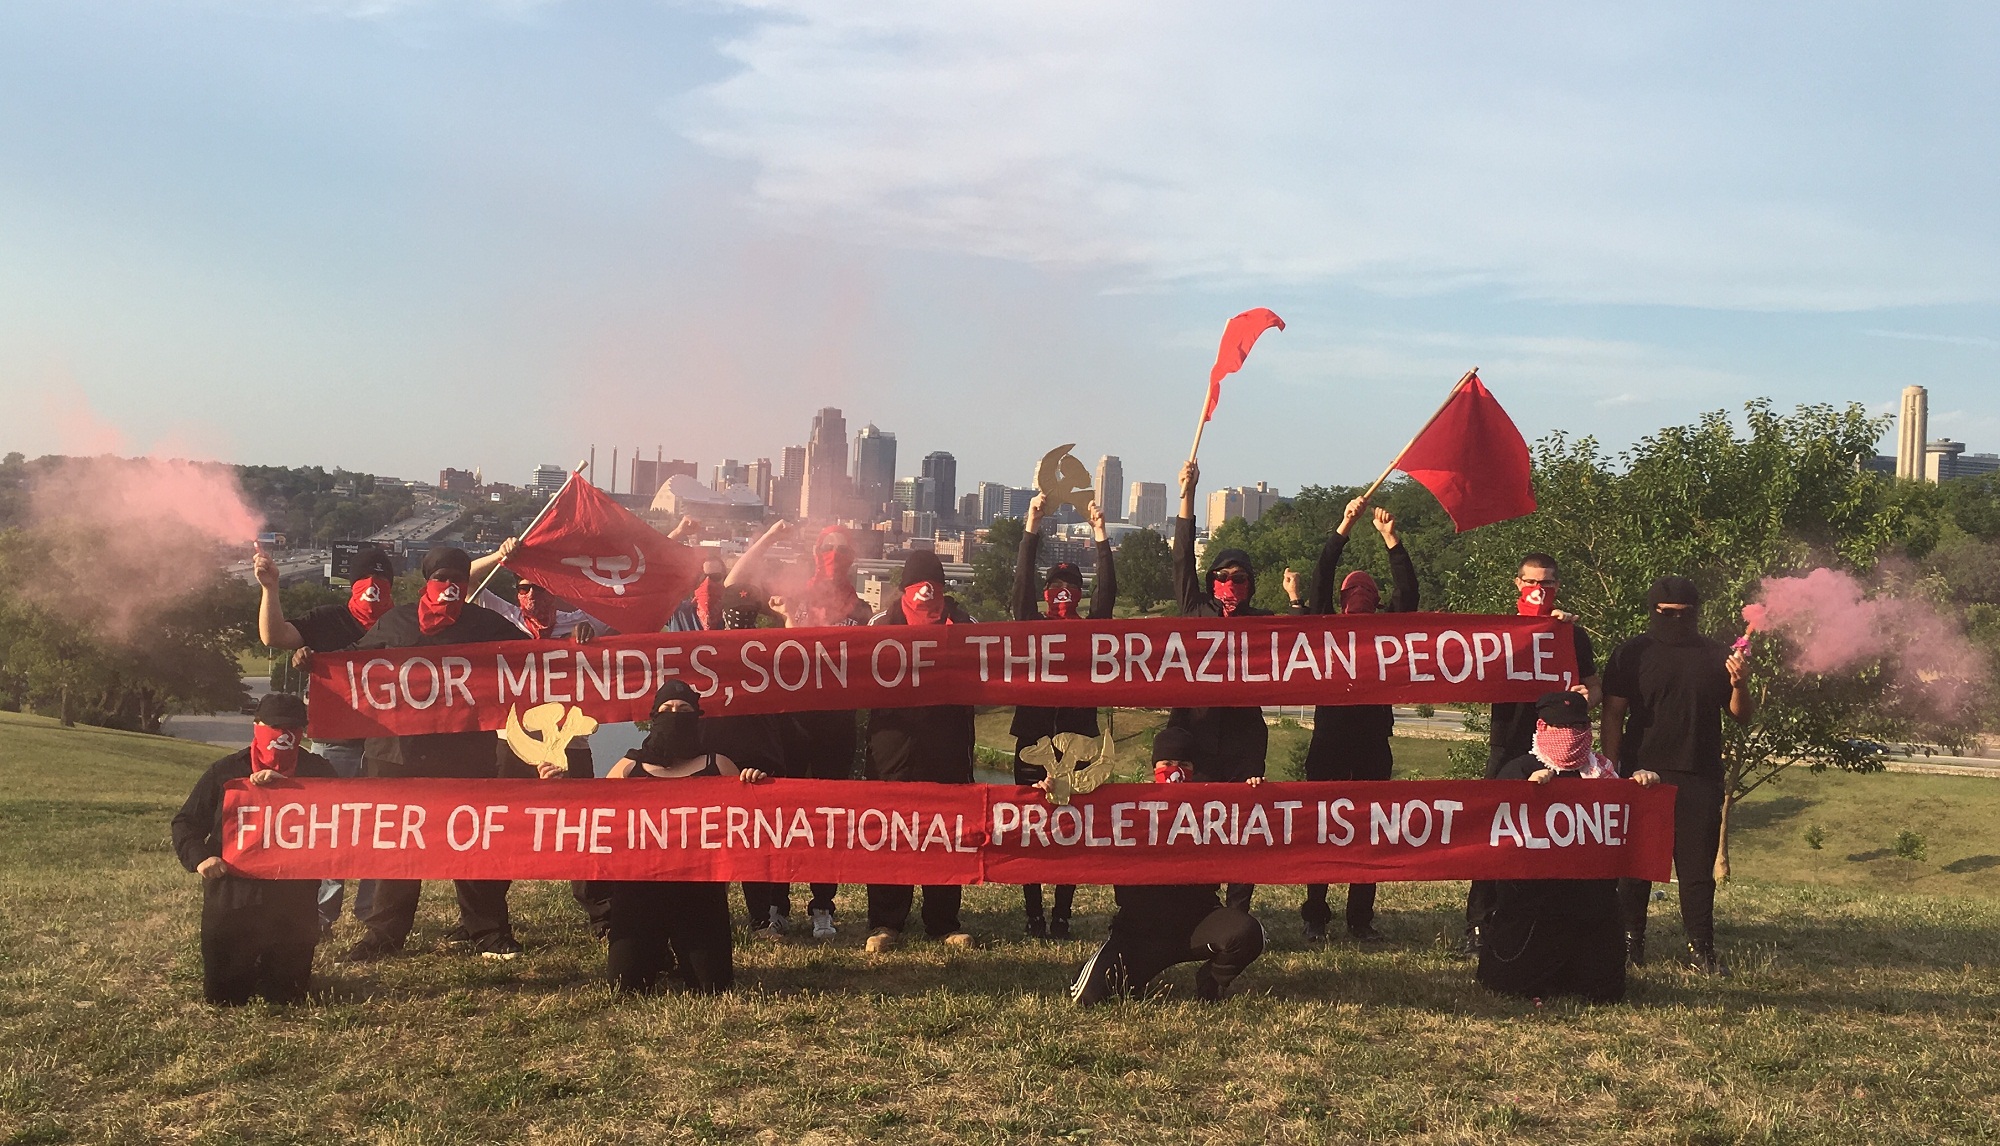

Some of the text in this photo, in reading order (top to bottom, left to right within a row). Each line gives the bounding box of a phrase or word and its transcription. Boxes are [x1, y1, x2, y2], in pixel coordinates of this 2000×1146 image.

[346, 656, 476, 710] IGOR
[871, 638, 938, 688] OF
[965, 634, 1069, 683] THE
[1090, 631, 1357, 683] BRAZILIAN
[1373, 630, 1573, 692] PEOPLE,
[236, 799, 1630, 854] FIGHTER OF THE INTERNATIONAL PROLETARIAT IS NOT ALONE!
